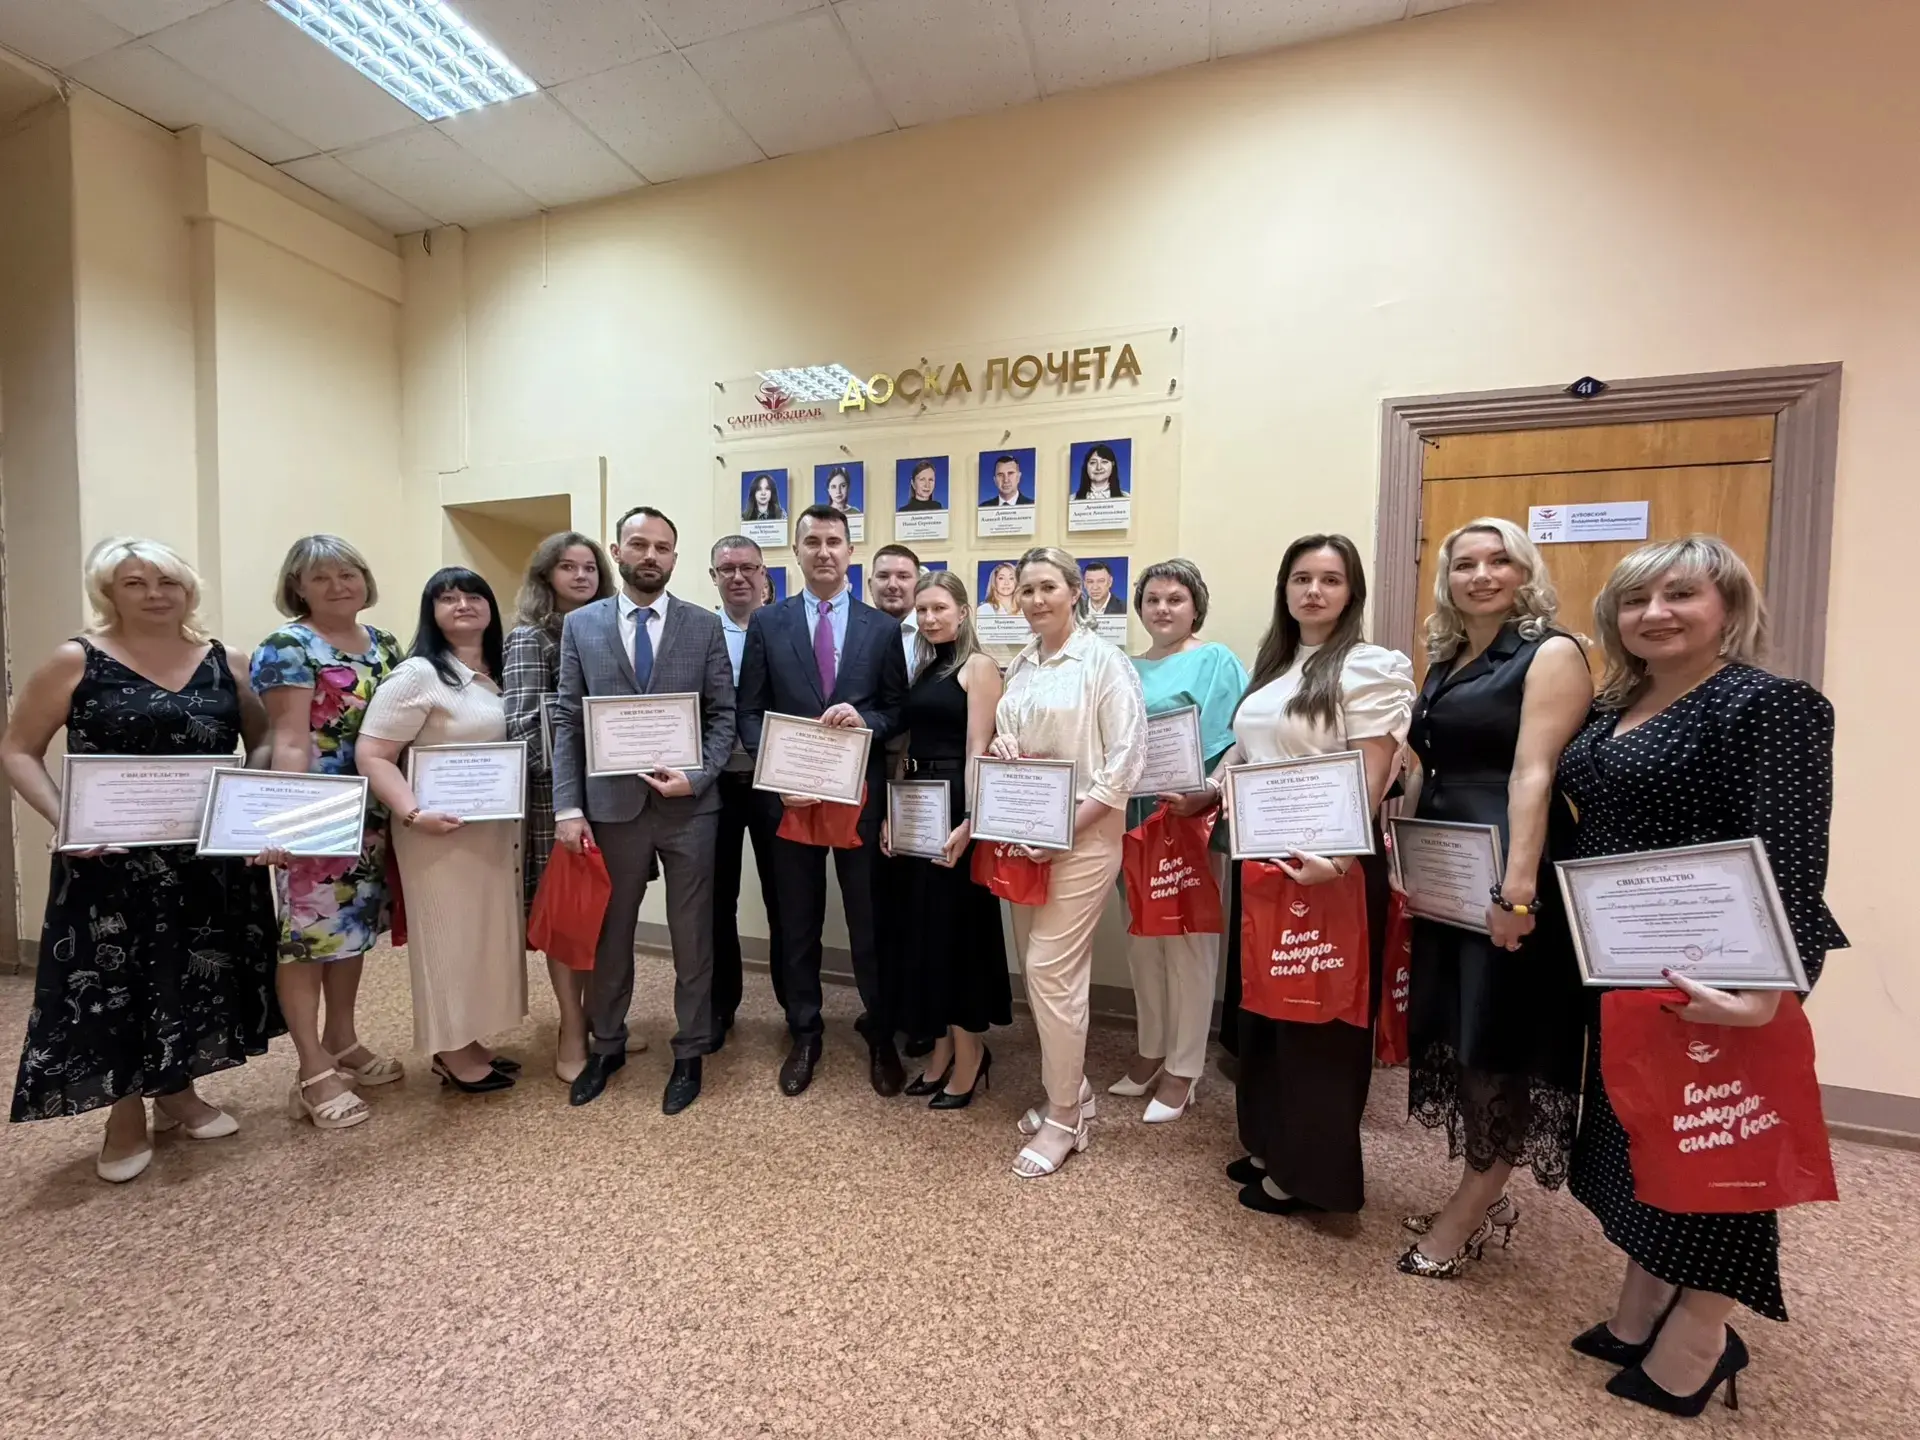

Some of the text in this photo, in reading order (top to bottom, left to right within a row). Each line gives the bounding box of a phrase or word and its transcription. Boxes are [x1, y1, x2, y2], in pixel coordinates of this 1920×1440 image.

[839, 343, 1142, 413] ДОСКА ПОЧЕТА
[1577, 381, 1593, 394] 41
[727, 407, 822, 426] САРПРОФЗДРАВ
[1540, 531, 1553, 541] 41
[1266, 775, 1320, 786] СВИДЕТЕЛЬСТВО
[1616, 872, 1695, 887] СВИДЕТЕЛЬСТВО
[1151, 885, 1179, 900] сила
[1281, 929, 1320, 946] Голос
[1270, 956, 1345, 977] сила всех
[1683, 1079, 1743, 1107] Голос
[1678, 1110, 1782, 1154] сила всех
